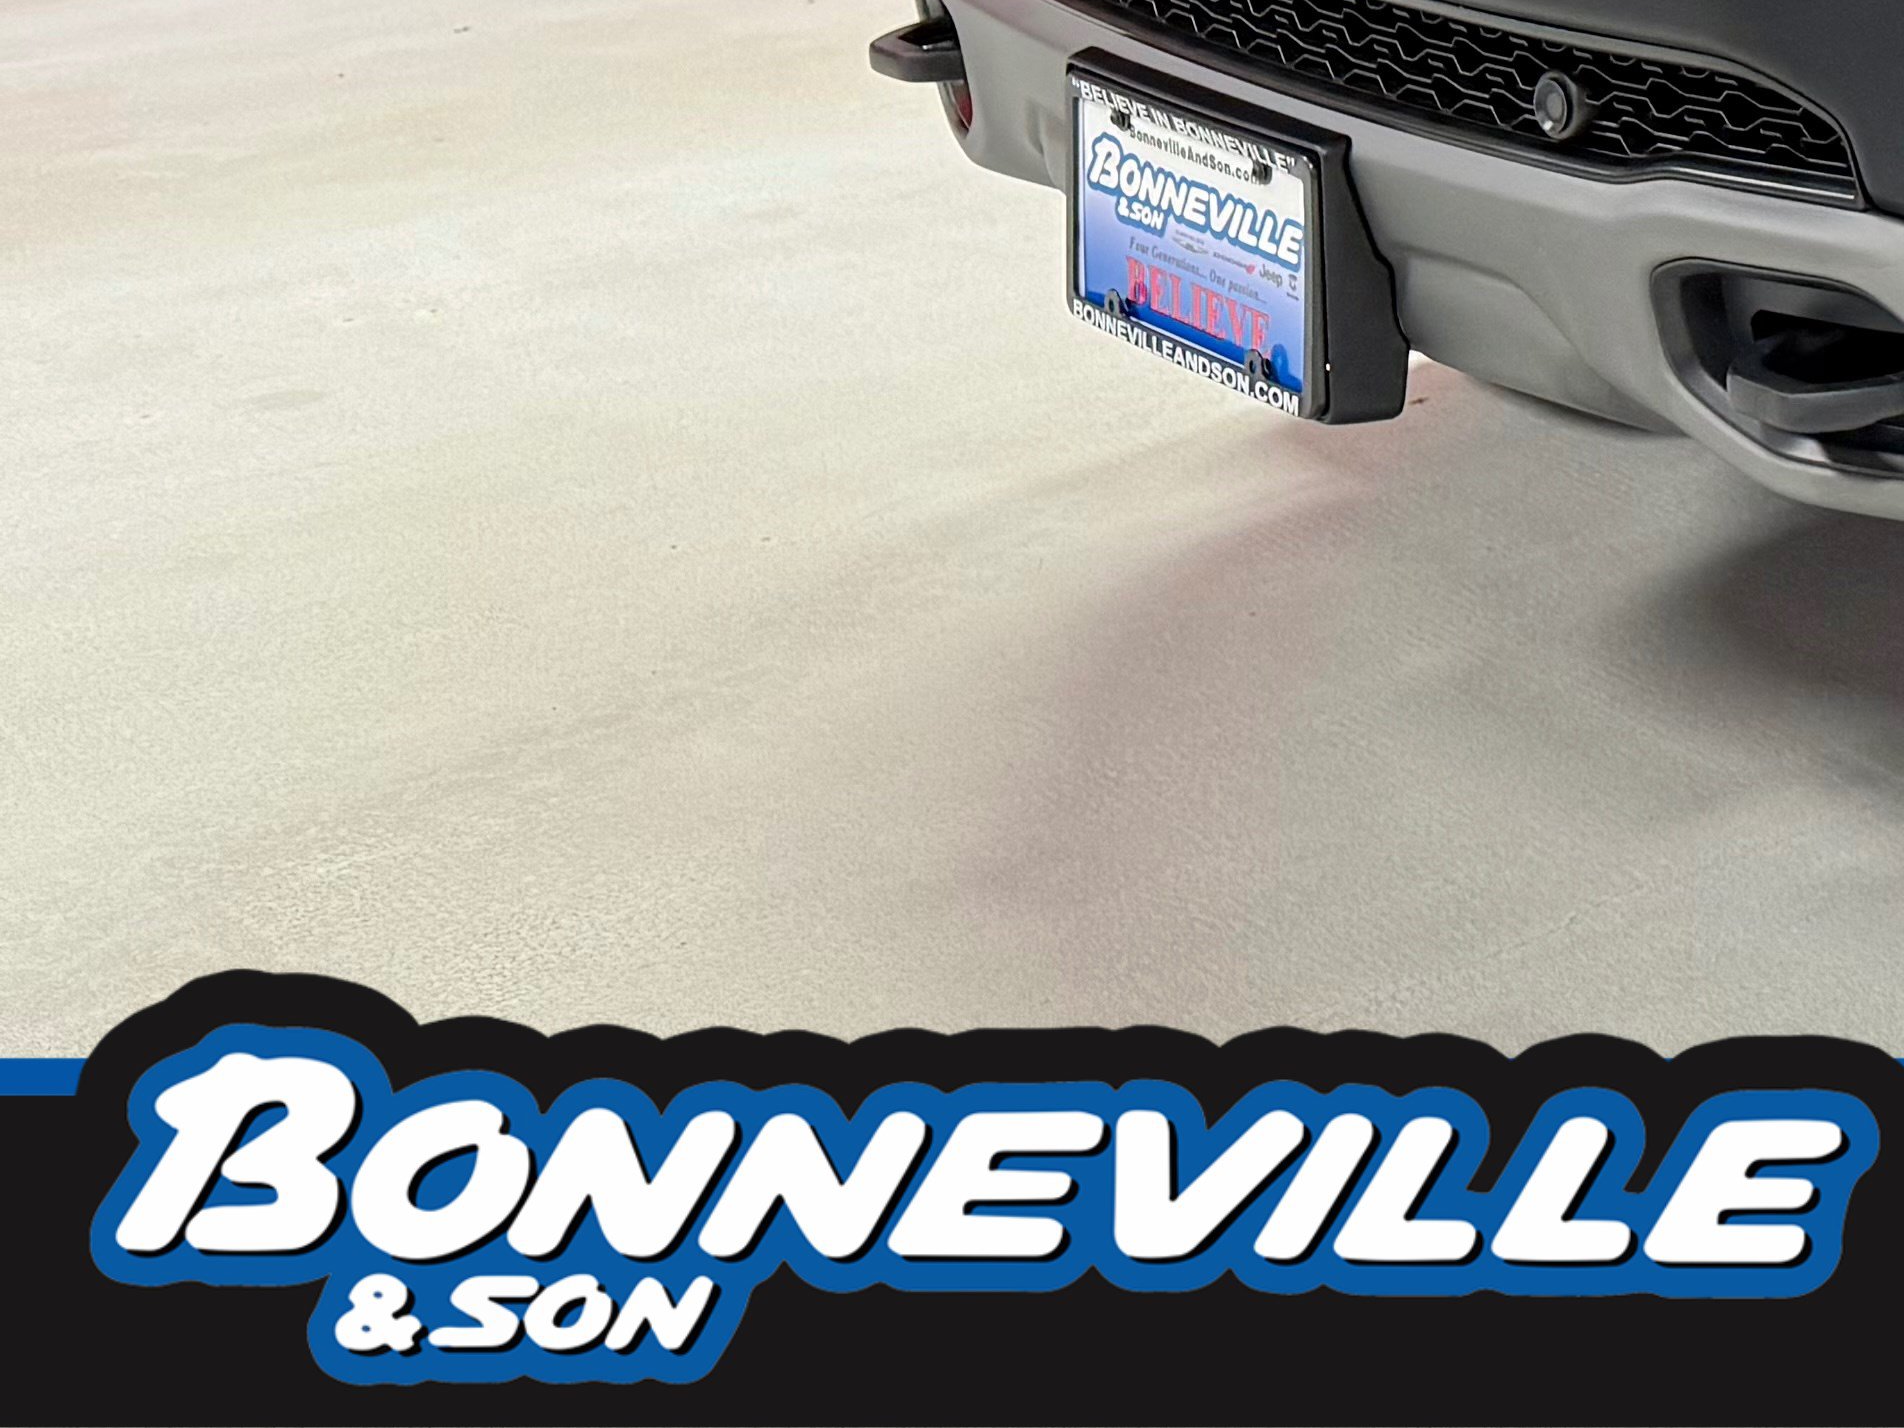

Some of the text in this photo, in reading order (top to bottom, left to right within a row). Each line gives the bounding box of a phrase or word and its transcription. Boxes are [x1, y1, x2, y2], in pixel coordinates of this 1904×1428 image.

[1150, 108, 1172, 130] IN
[1089, 136, 1303, 265] BONNEVILLE
[1118, 197, 1165, 231] &SON
[1073, 298, 1300, 417] BONNEVILLEANDSON.COM
[1126, 255, 1272, 360] BELIEVE
